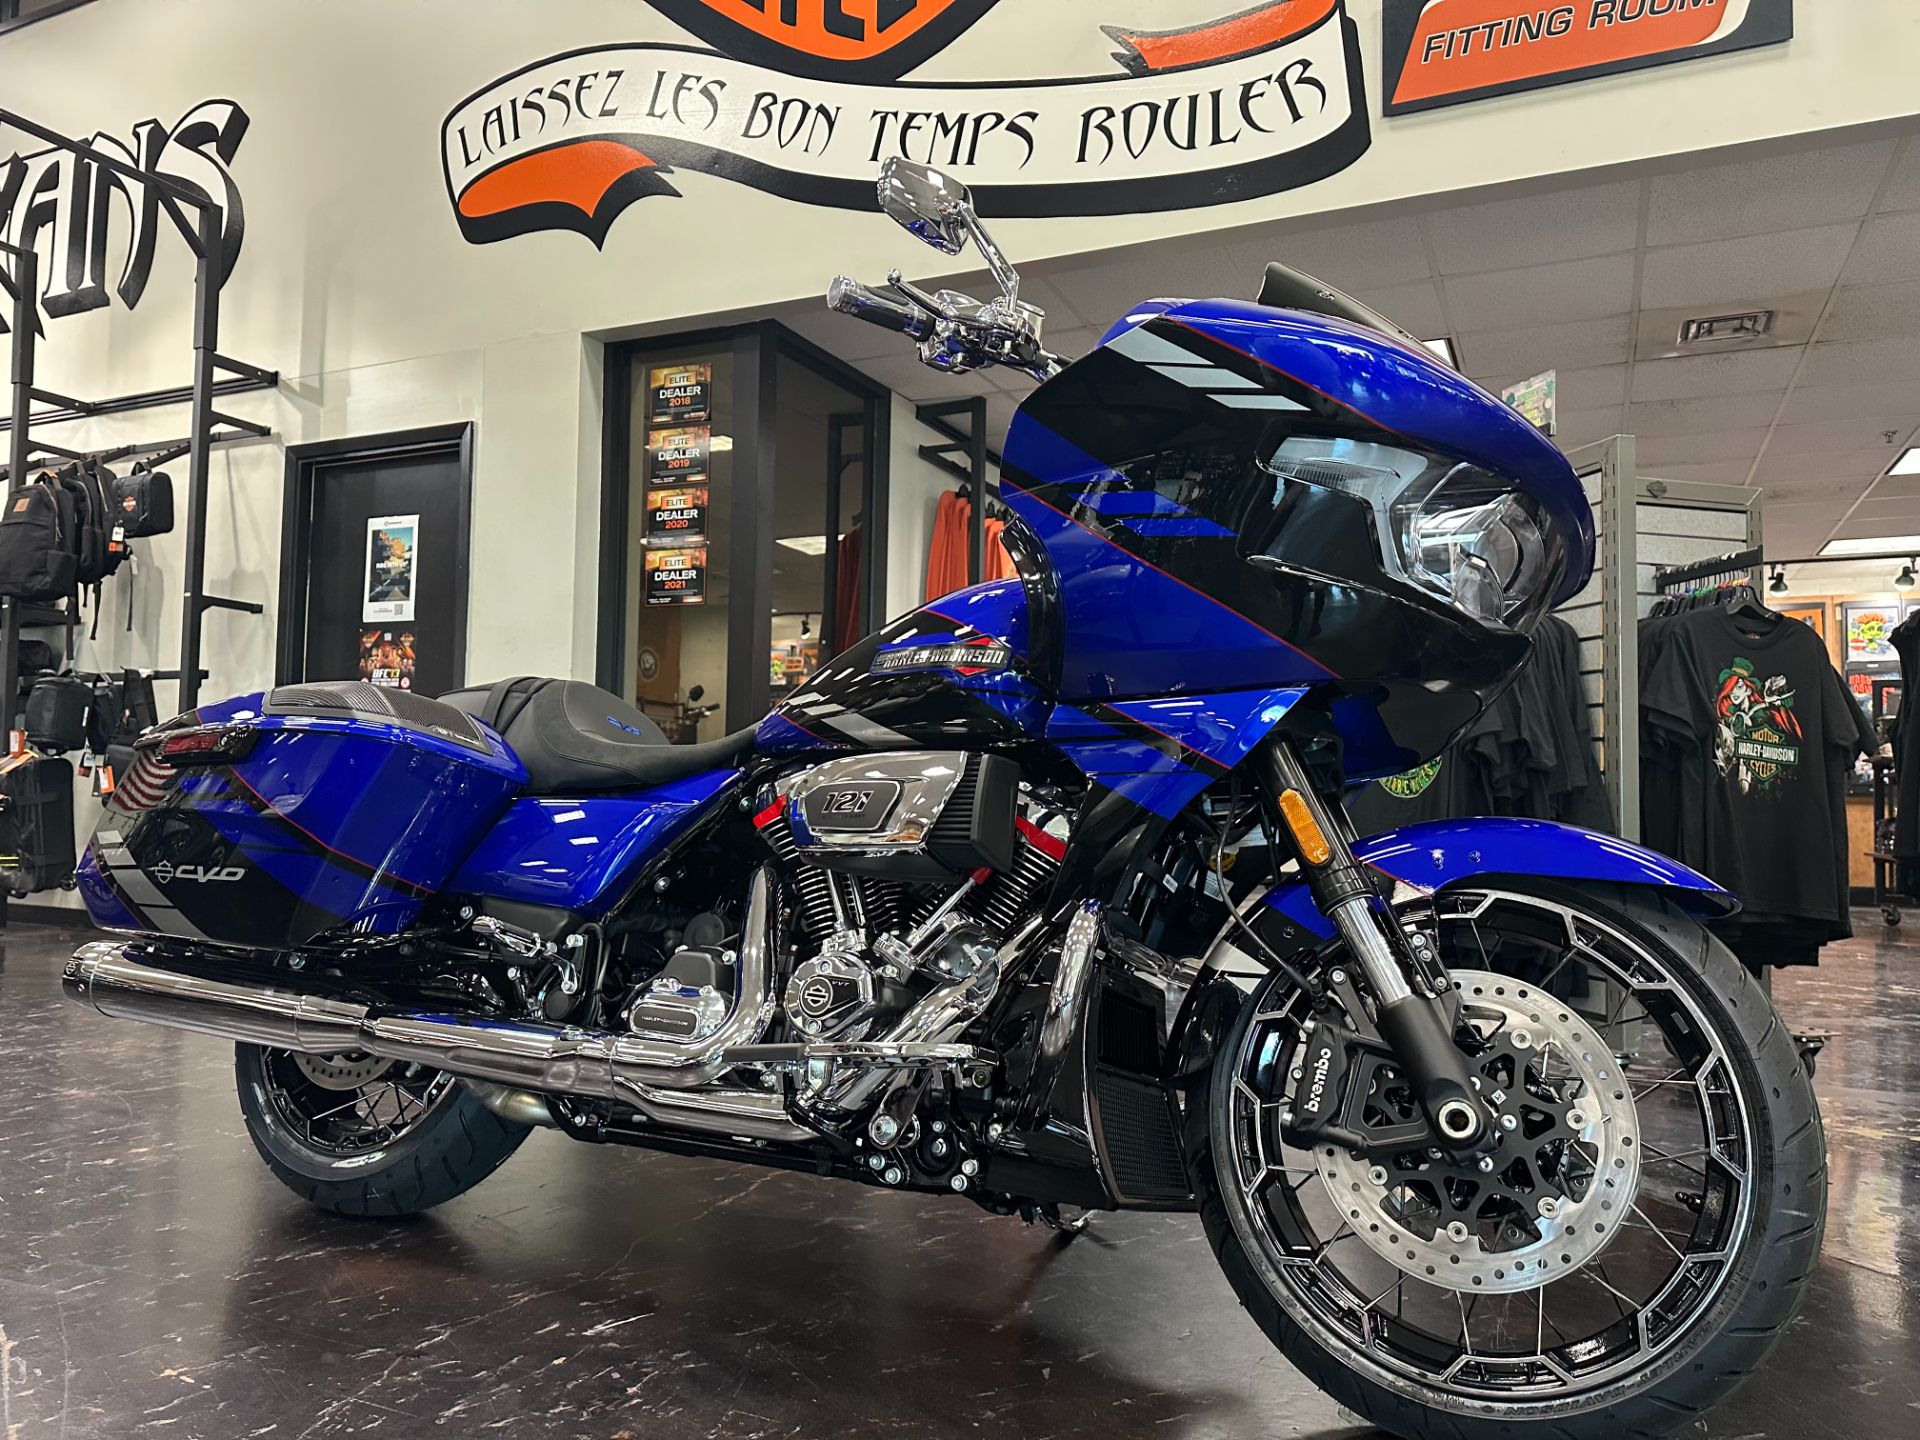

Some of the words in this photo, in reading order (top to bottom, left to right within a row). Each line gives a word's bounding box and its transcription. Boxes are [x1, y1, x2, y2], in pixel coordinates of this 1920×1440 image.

[1421, 6, 1574, 64] FITTING
[457, 70, 624, 168] LAISSEZ
[646, 70, 727, 131] LES
[741, 92, 842, 157] BON
[868, 109, 1039, 169] TEMPS
[1074, 58, 1327, 166] ROULER
[669, 375, 692, 384] ELITE
[659, 386, 701, 399] DEALER
[669, 397, 691, 406] 2018
[668, 437, 690, 446] ELITE
[658, 448, 700, 461] DEALER
[668, 459, 689, 468] 2019
[656, 509, 698, 521] DEALER
[665, 520, 688, 529] 2020
[664, 559, 686, 567] ELITE
[654, 570, 696, 581] DEALER
[664, 580, 686, 589] 2021
[1752, 728, 1779, 743] MOTOR
[1738, 741, 1795, 762] HARLEY-DAVIDSON
[1750, 759, 1776, 777] CYCLES
[821, 790, 874, 813] 121
[174, 864, 245, 882] CVO
[1304, 1048, 1331, 1112] brembo
